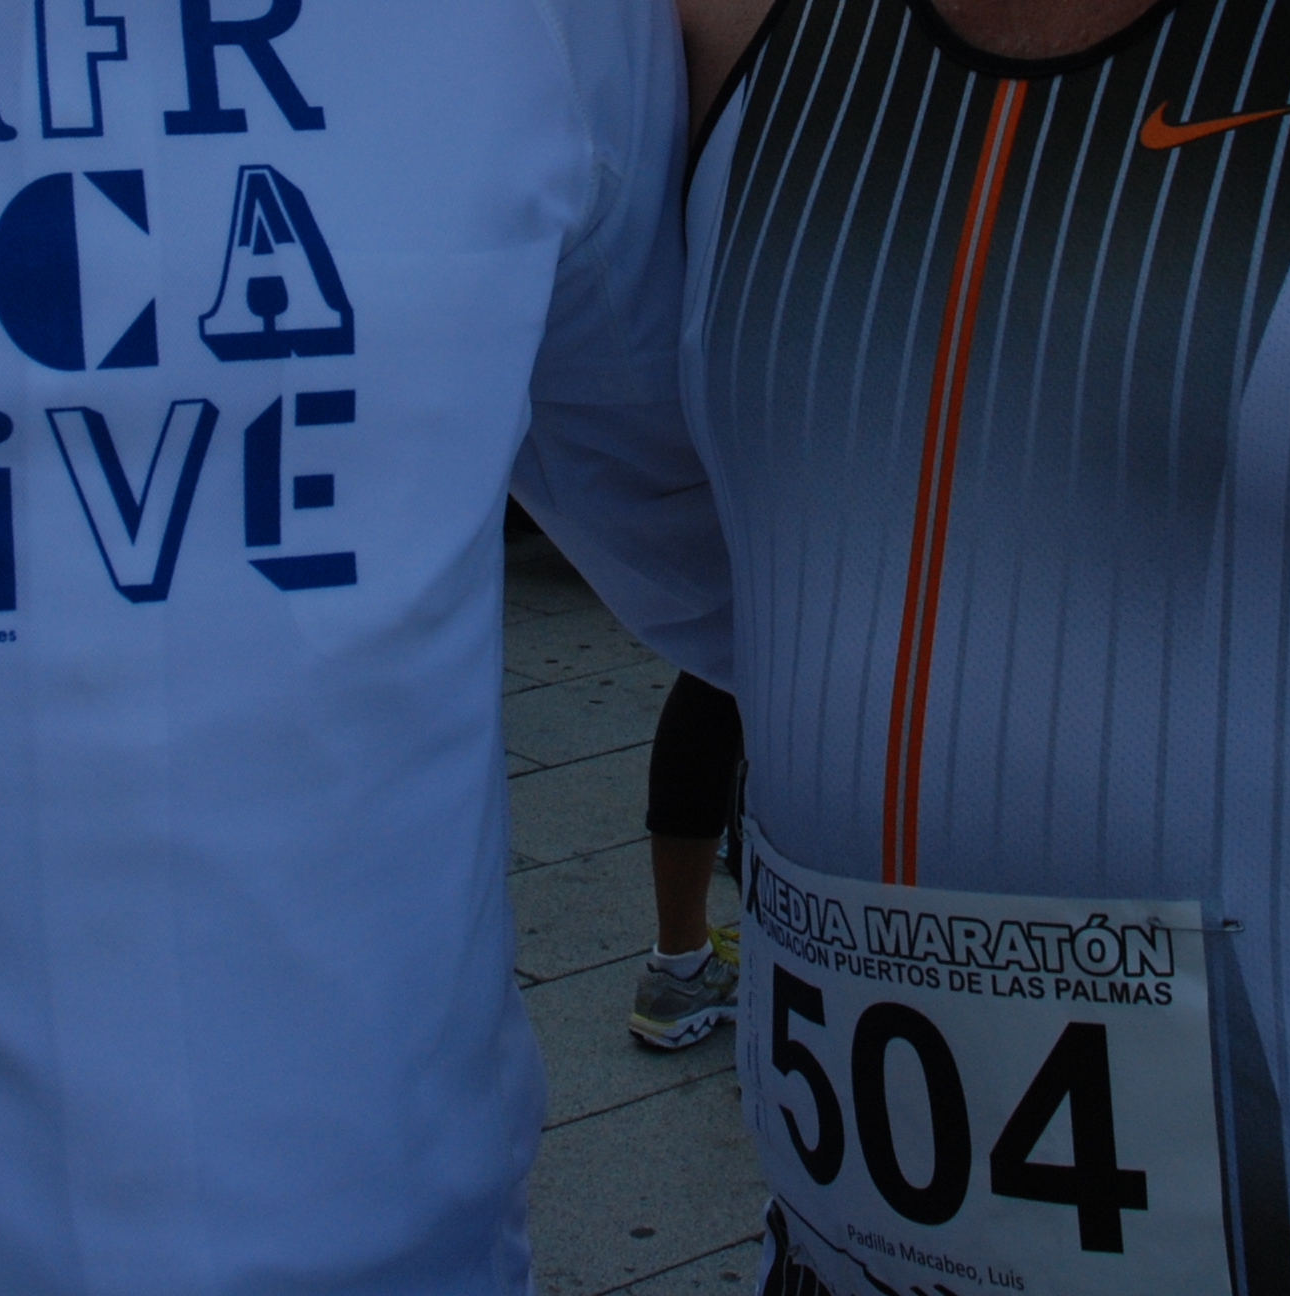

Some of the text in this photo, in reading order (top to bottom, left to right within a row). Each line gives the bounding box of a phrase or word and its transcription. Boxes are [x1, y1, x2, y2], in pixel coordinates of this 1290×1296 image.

[760, 856, 857, 951] MEDIA
[864, 905, 1175, 977] MARATÓN
[835, 951, 940, 990] PUERTOS
[949, 970, 983, 995] DE
[991, 974, 1045, 1000] LAS
[1054, 978, 1173, 1006] PALMAS
[772, 962, 1148, 1255] 504
[847, 1223, 1025, 1292] Padilla Macabeo, Luis
